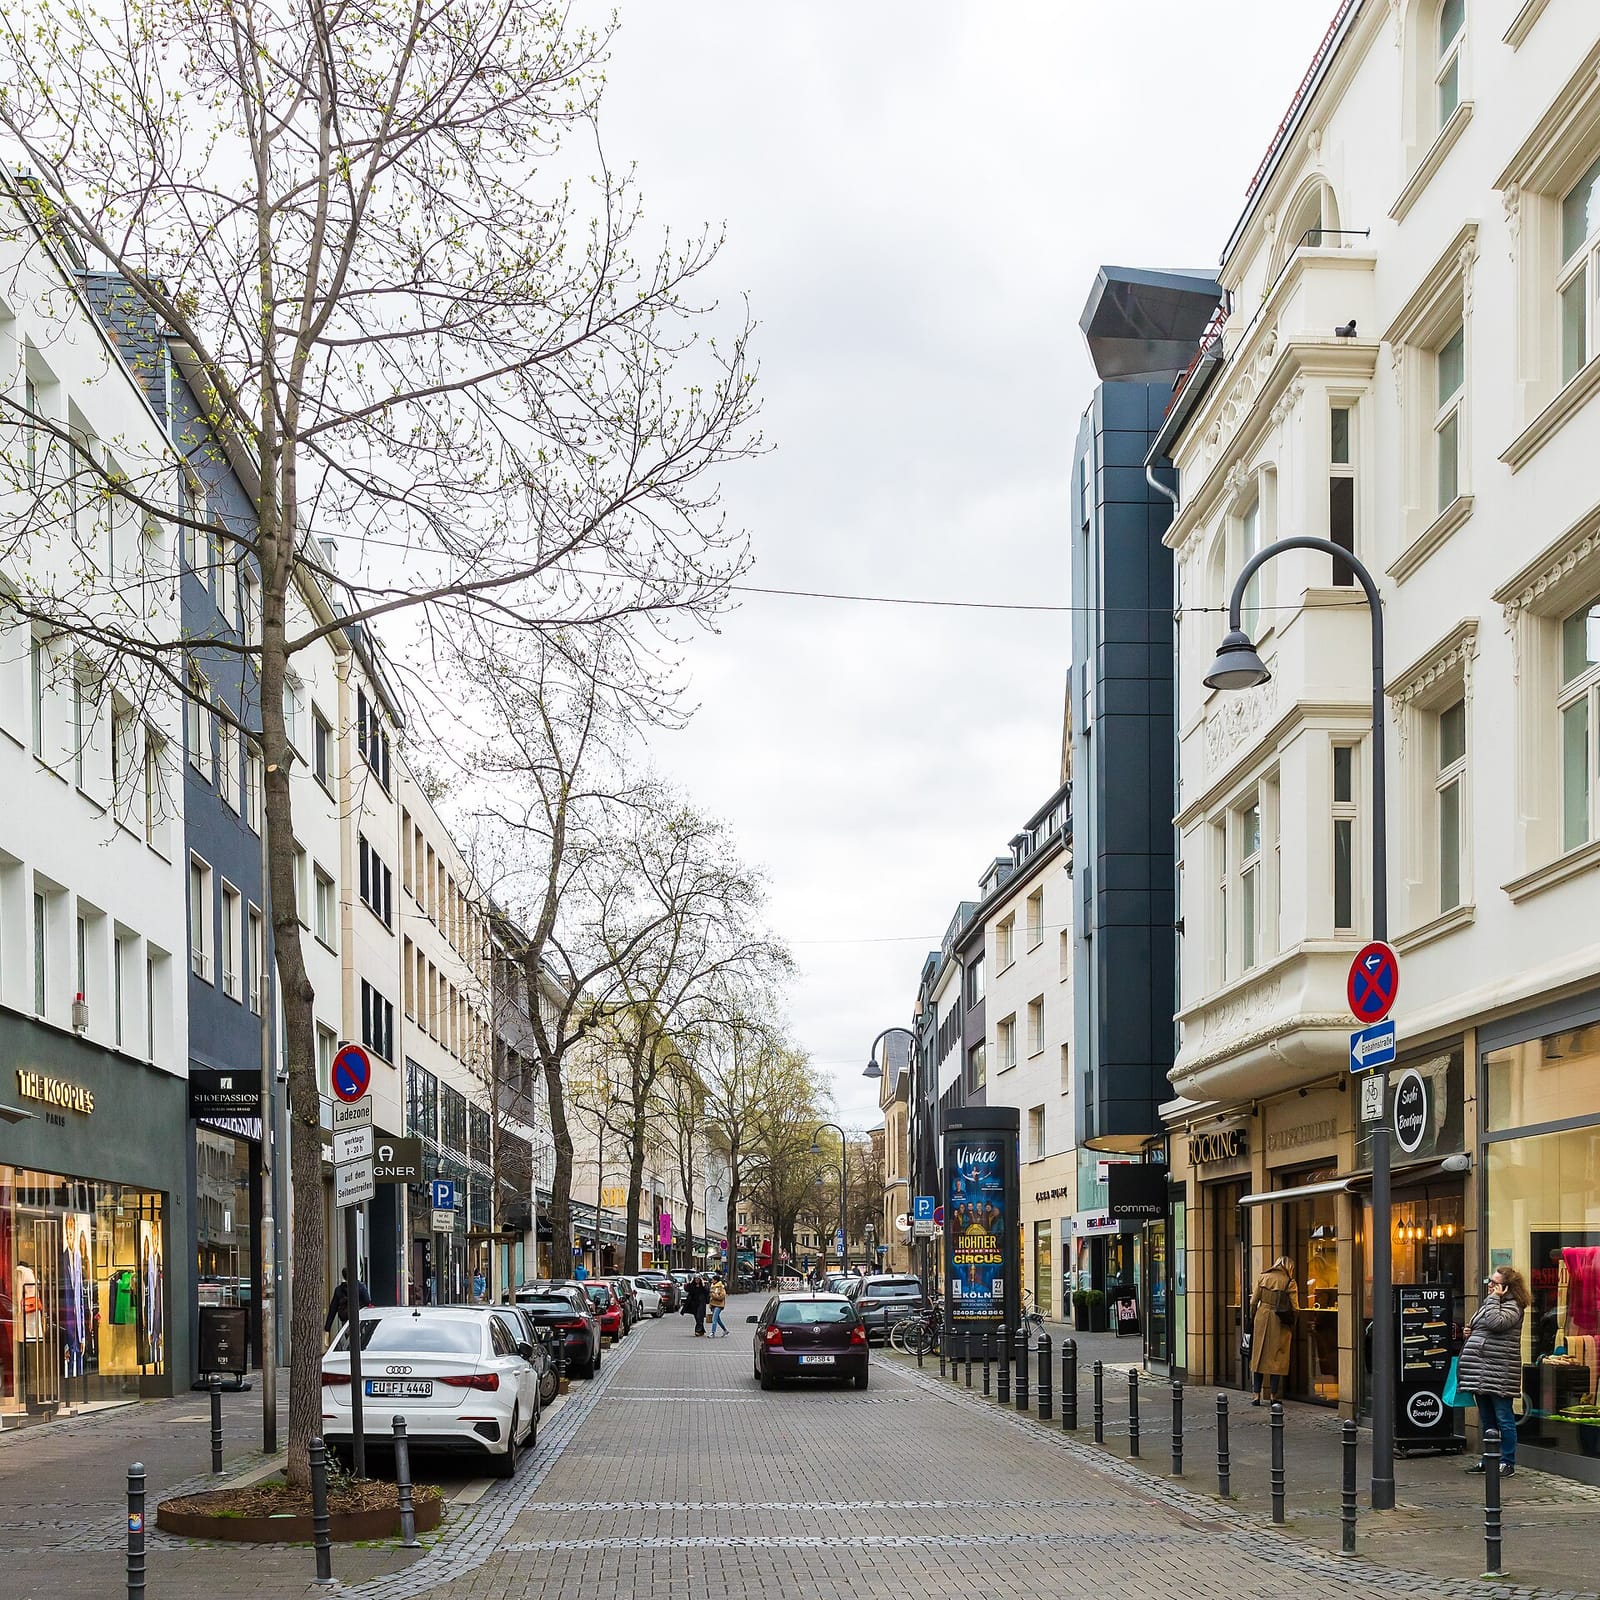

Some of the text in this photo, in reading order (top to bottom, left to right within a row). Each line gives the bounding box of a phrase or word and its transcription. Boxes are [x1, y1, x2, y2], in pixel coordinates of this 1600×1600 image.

[1362, 1035, 1392, 1054] Einbahnstraße
[16, 1070, 95, 1114] THE KOOPLES
[194, 1094, 259, 1102] SHOEPASSION
[1401, 1086, 1419, 1104] Sushi
[46, 1112, 65, 1127] PARIS
[335, 1107, 370, 1122] Ladezone
[1399, 1113, 1423, 1131] Boutique
[355, 1170, 366, 1180] dem
[373, 1166, 416, 1176] GNER
[337, 1182, 373, 1198] Seitenstreifen
[438, 1184, 449, 1206] P
[919, 1199, 930, 1217] P
[1422, 1291, 1438, 1300] TOP
[1439, 1291, 1445, 1300] 5
[372, 1382, 431, 1394] EU FI 4448
[1415, 1399, 1434, 1407] Sushi
